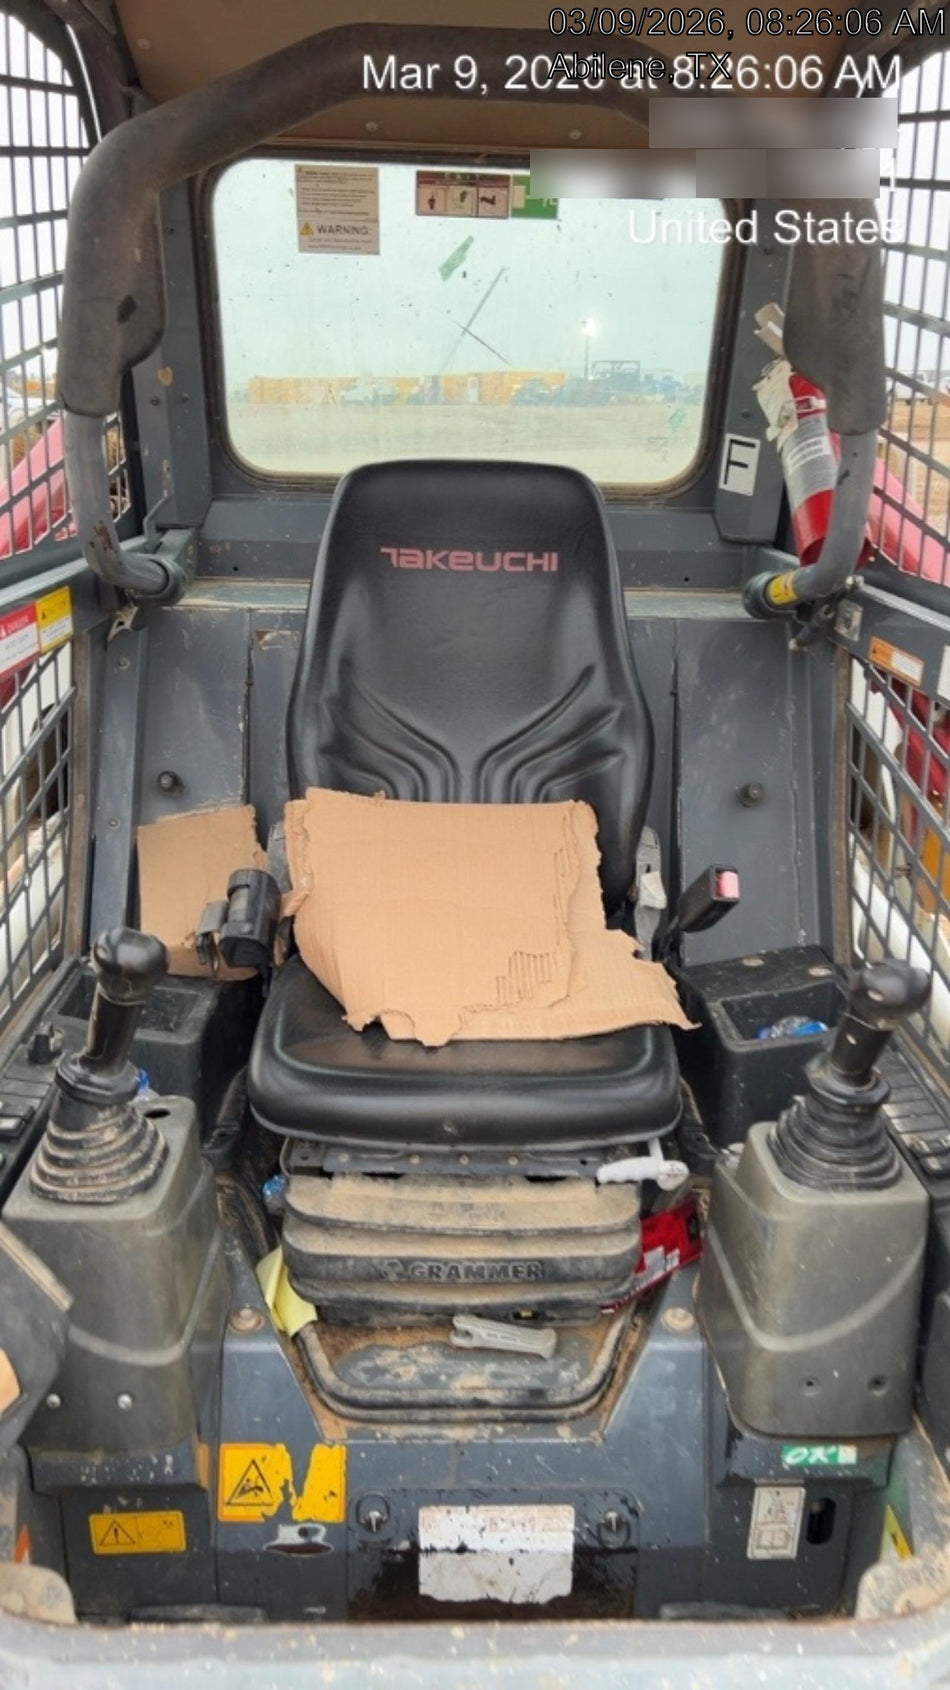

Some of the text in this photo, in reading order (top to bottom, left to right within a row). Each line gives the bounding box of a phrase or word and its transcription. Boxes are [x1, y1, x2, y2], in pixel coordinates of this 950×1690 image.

[317, 223, 369, 236] WARNING
[723, 438, 756, 486] F
[408, 1260, 544, 1281] GRAMMER
